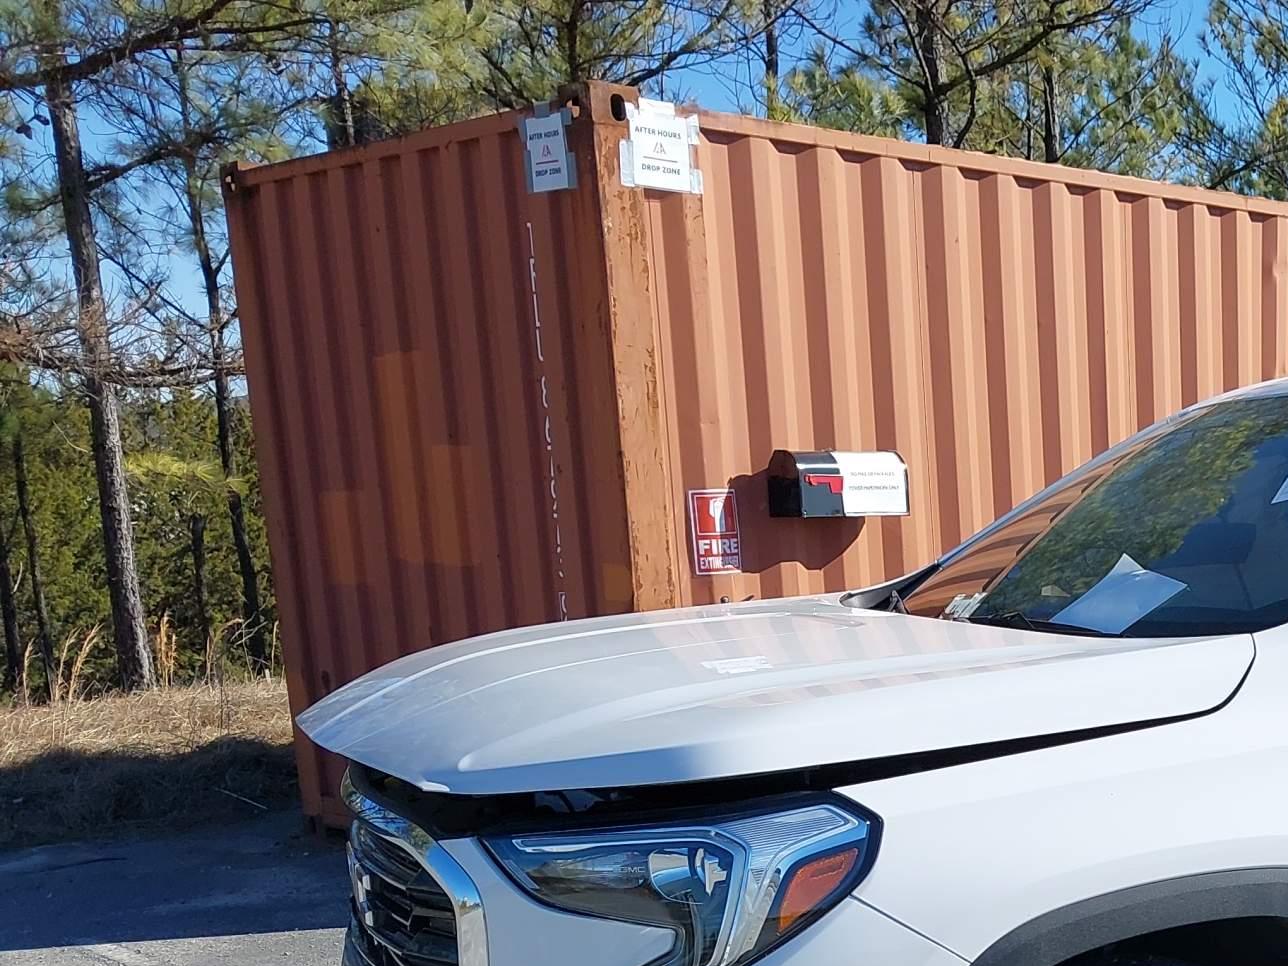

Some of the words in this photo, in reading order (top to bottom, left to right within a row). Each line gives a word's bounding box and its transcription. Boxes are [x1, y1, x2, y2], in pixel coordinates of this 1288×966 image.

[635, 125, 656, 136] AFTER
[657, 129, 682, 140] HOURS
[641, 163, 661, 172] DROP
[662, 166, 681, 176] ZONE
[698, 538, 738, 555] FIRE
